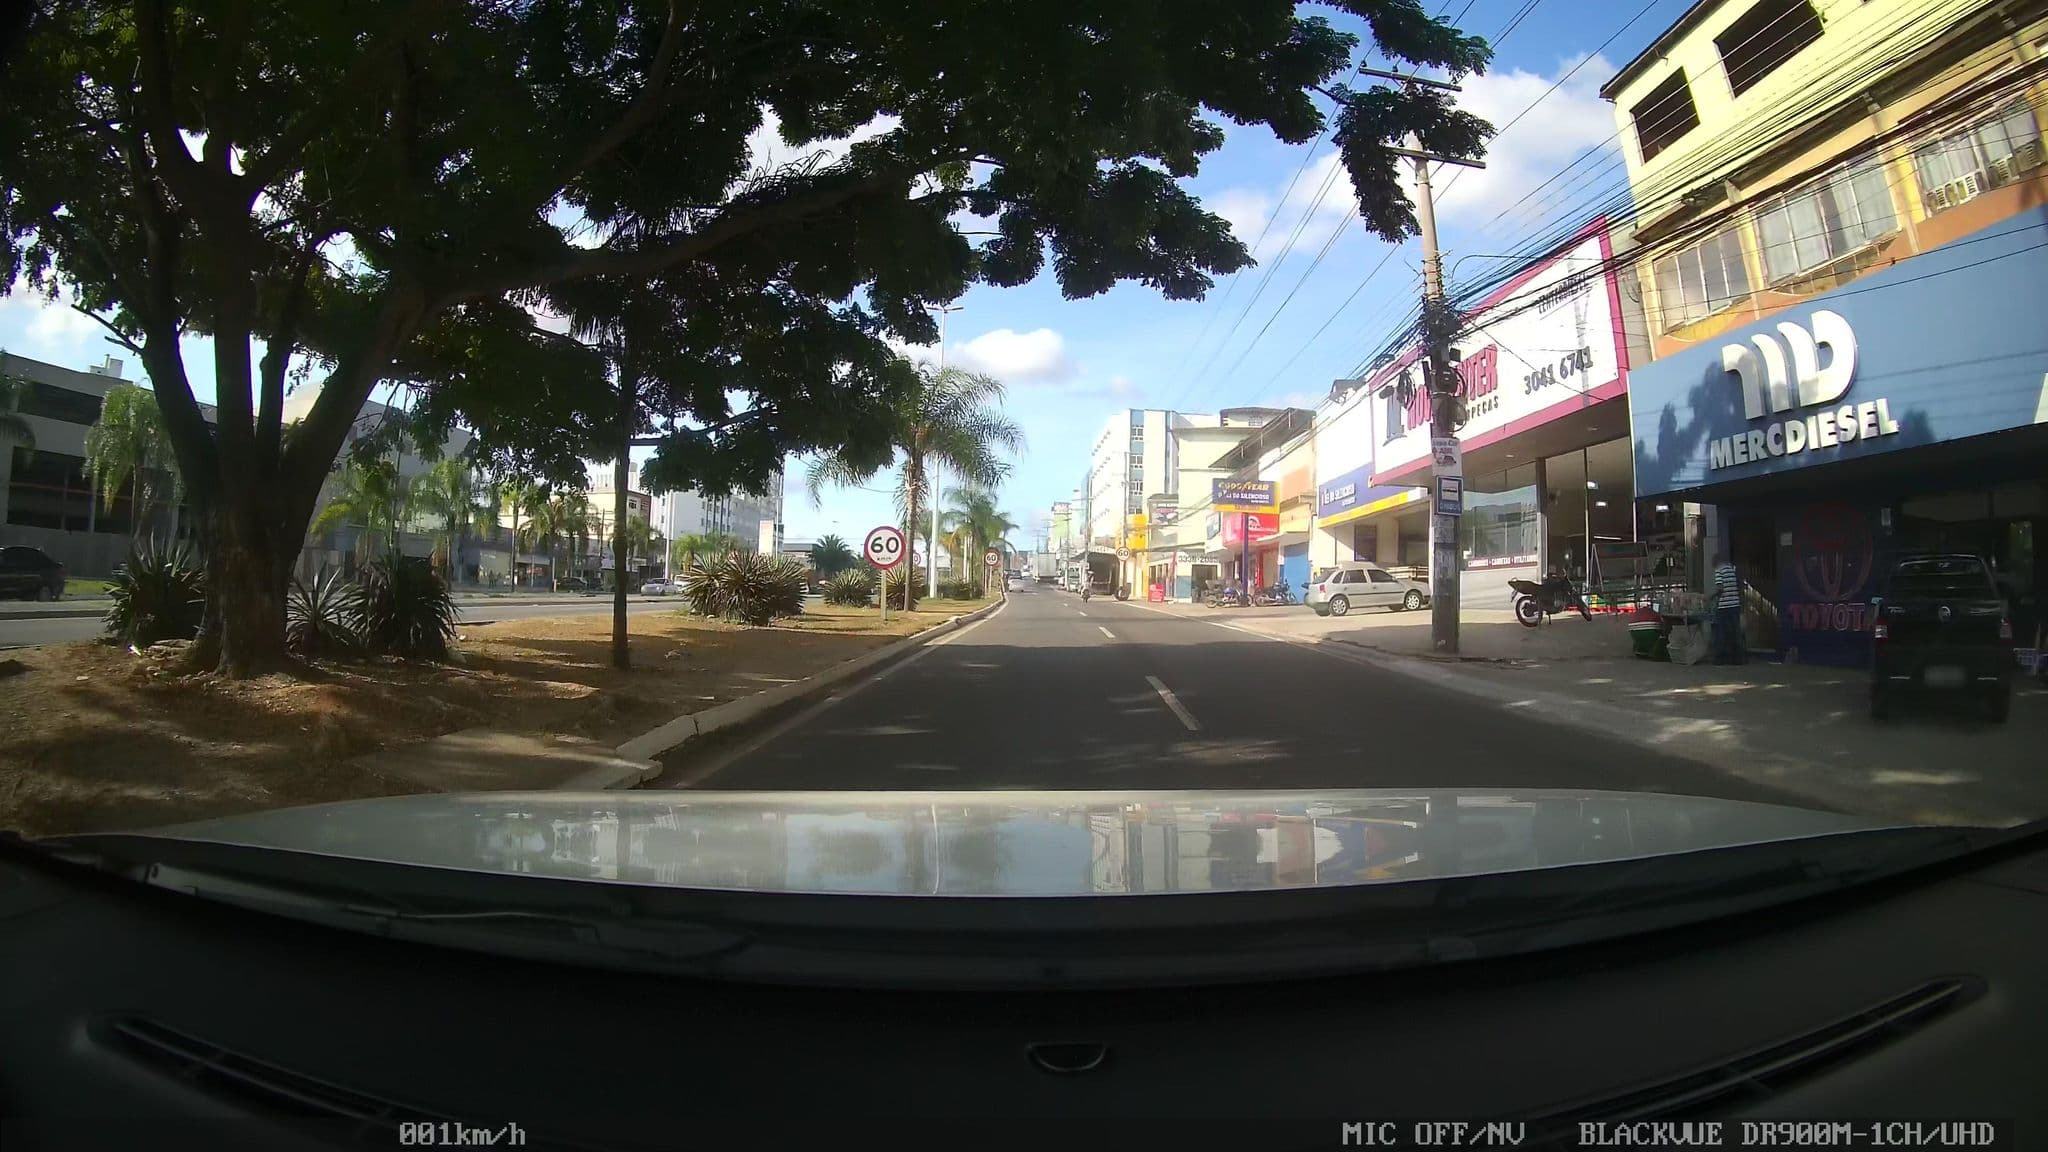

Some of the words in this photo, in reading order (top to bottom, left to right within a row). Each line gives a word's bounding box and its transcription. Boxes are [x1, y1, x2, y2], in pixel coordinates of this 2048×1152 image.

[1523, 363, 1556, 395] 3041
[1559, 345, 1594, 380] 6741
[1710, 398, 1900, 470] MERCDIESEL
[871, 536, 899, 553] 60
